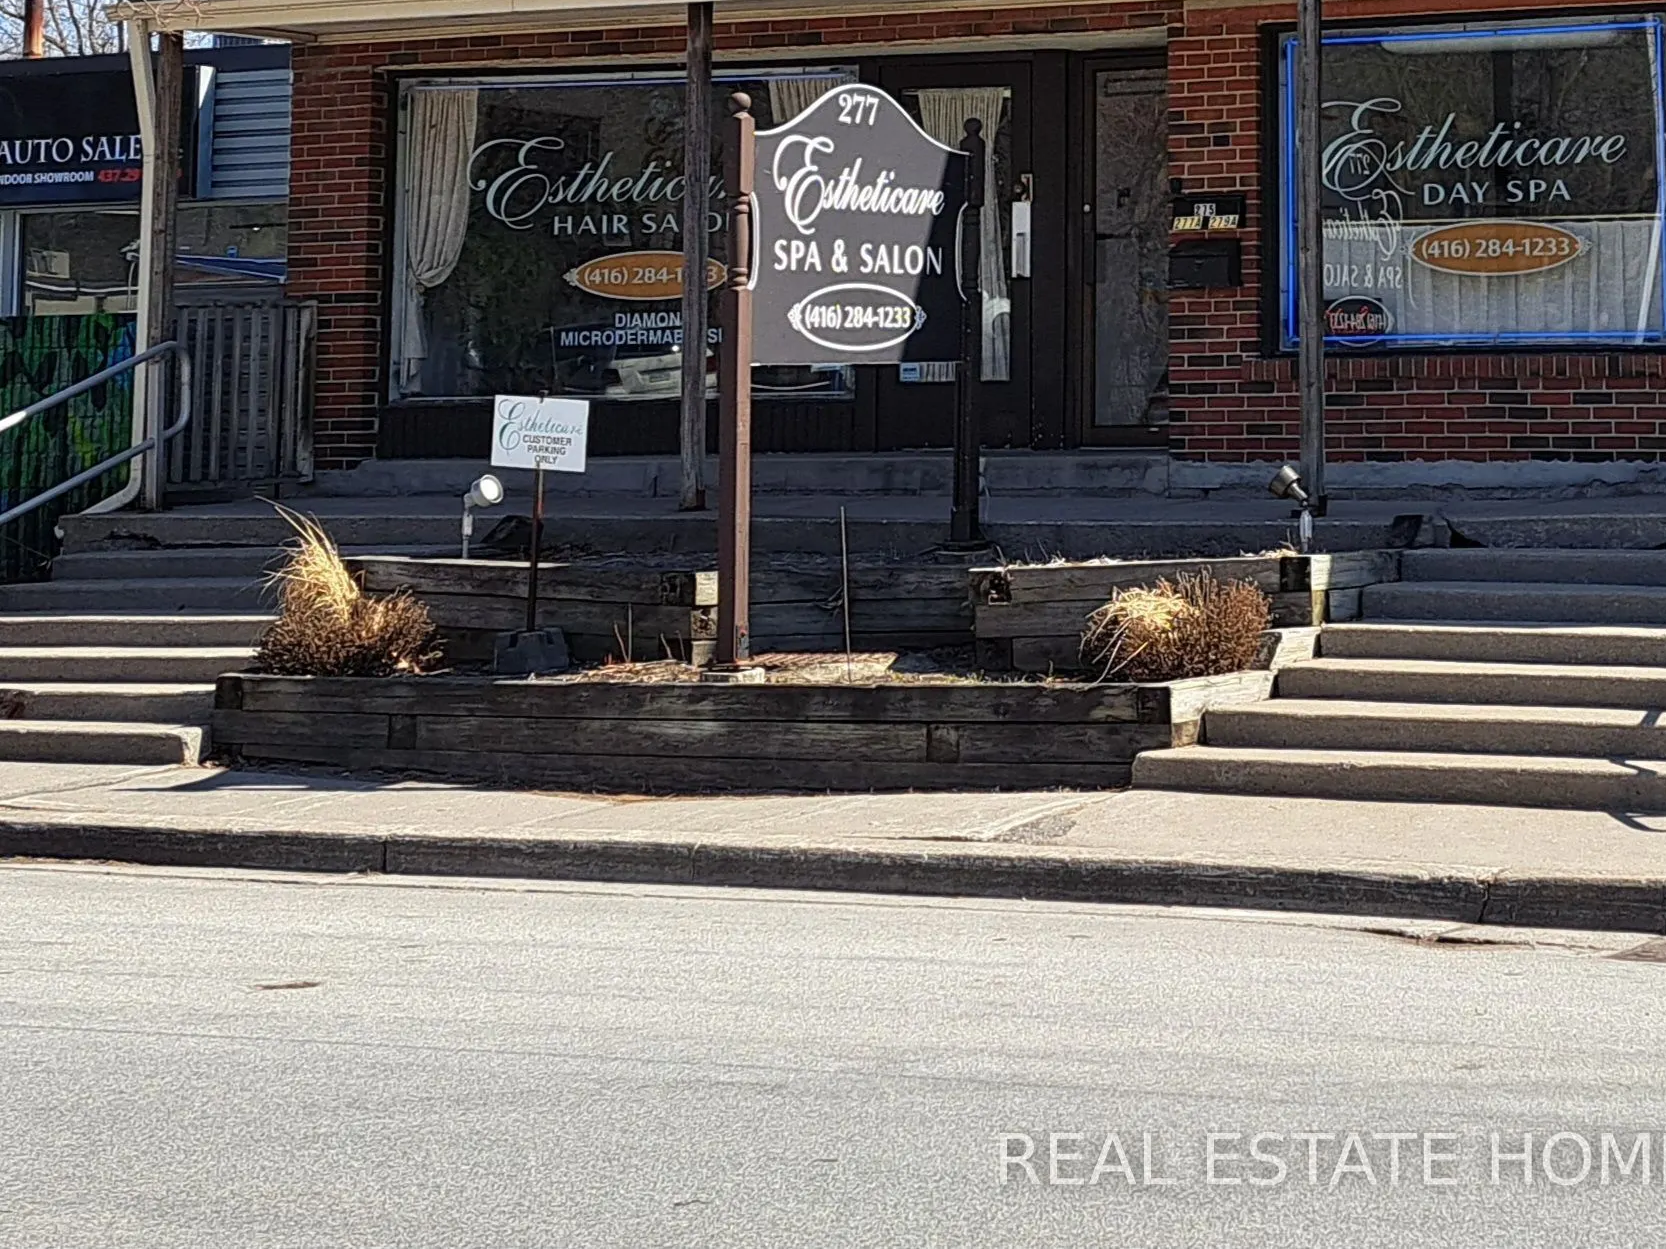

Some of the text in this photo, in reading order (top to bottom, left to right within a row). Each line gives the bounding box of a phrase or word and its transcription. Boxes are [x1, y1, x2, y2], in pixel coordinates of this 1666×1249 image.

[838, 94, 880, 126] 277
[0, 134, 142, 165] AUTO SALE
[1321, 97, 1627, 201] Estheticare
[34, 171, 94, 183] SHOWROOM
[773, 135, 945, 234] Estheticare
[1423, 179, 1572, 205] DAY SPA
[1195, 204, 1214, 215] 275
[553, 213, 629, 236] HAIR
[1210, 216, 1237, 228] 279A
[774, 239, 942, 275] SPA & SALON
[1421, 236, 1570, 260] (416) 284-1233
[584, 265, 717, 286] (416) 284-13
[615, 311, 682, 328] DIAMON
[805, 304, 911, 329] (416) 284-1233
[498, 399, 583, 456] Estheticare
[522, 434, 572, 446] CUSTOMER
[527, 445, 566, 456] PARKING
[534, 455, 558, 465] ONLY
